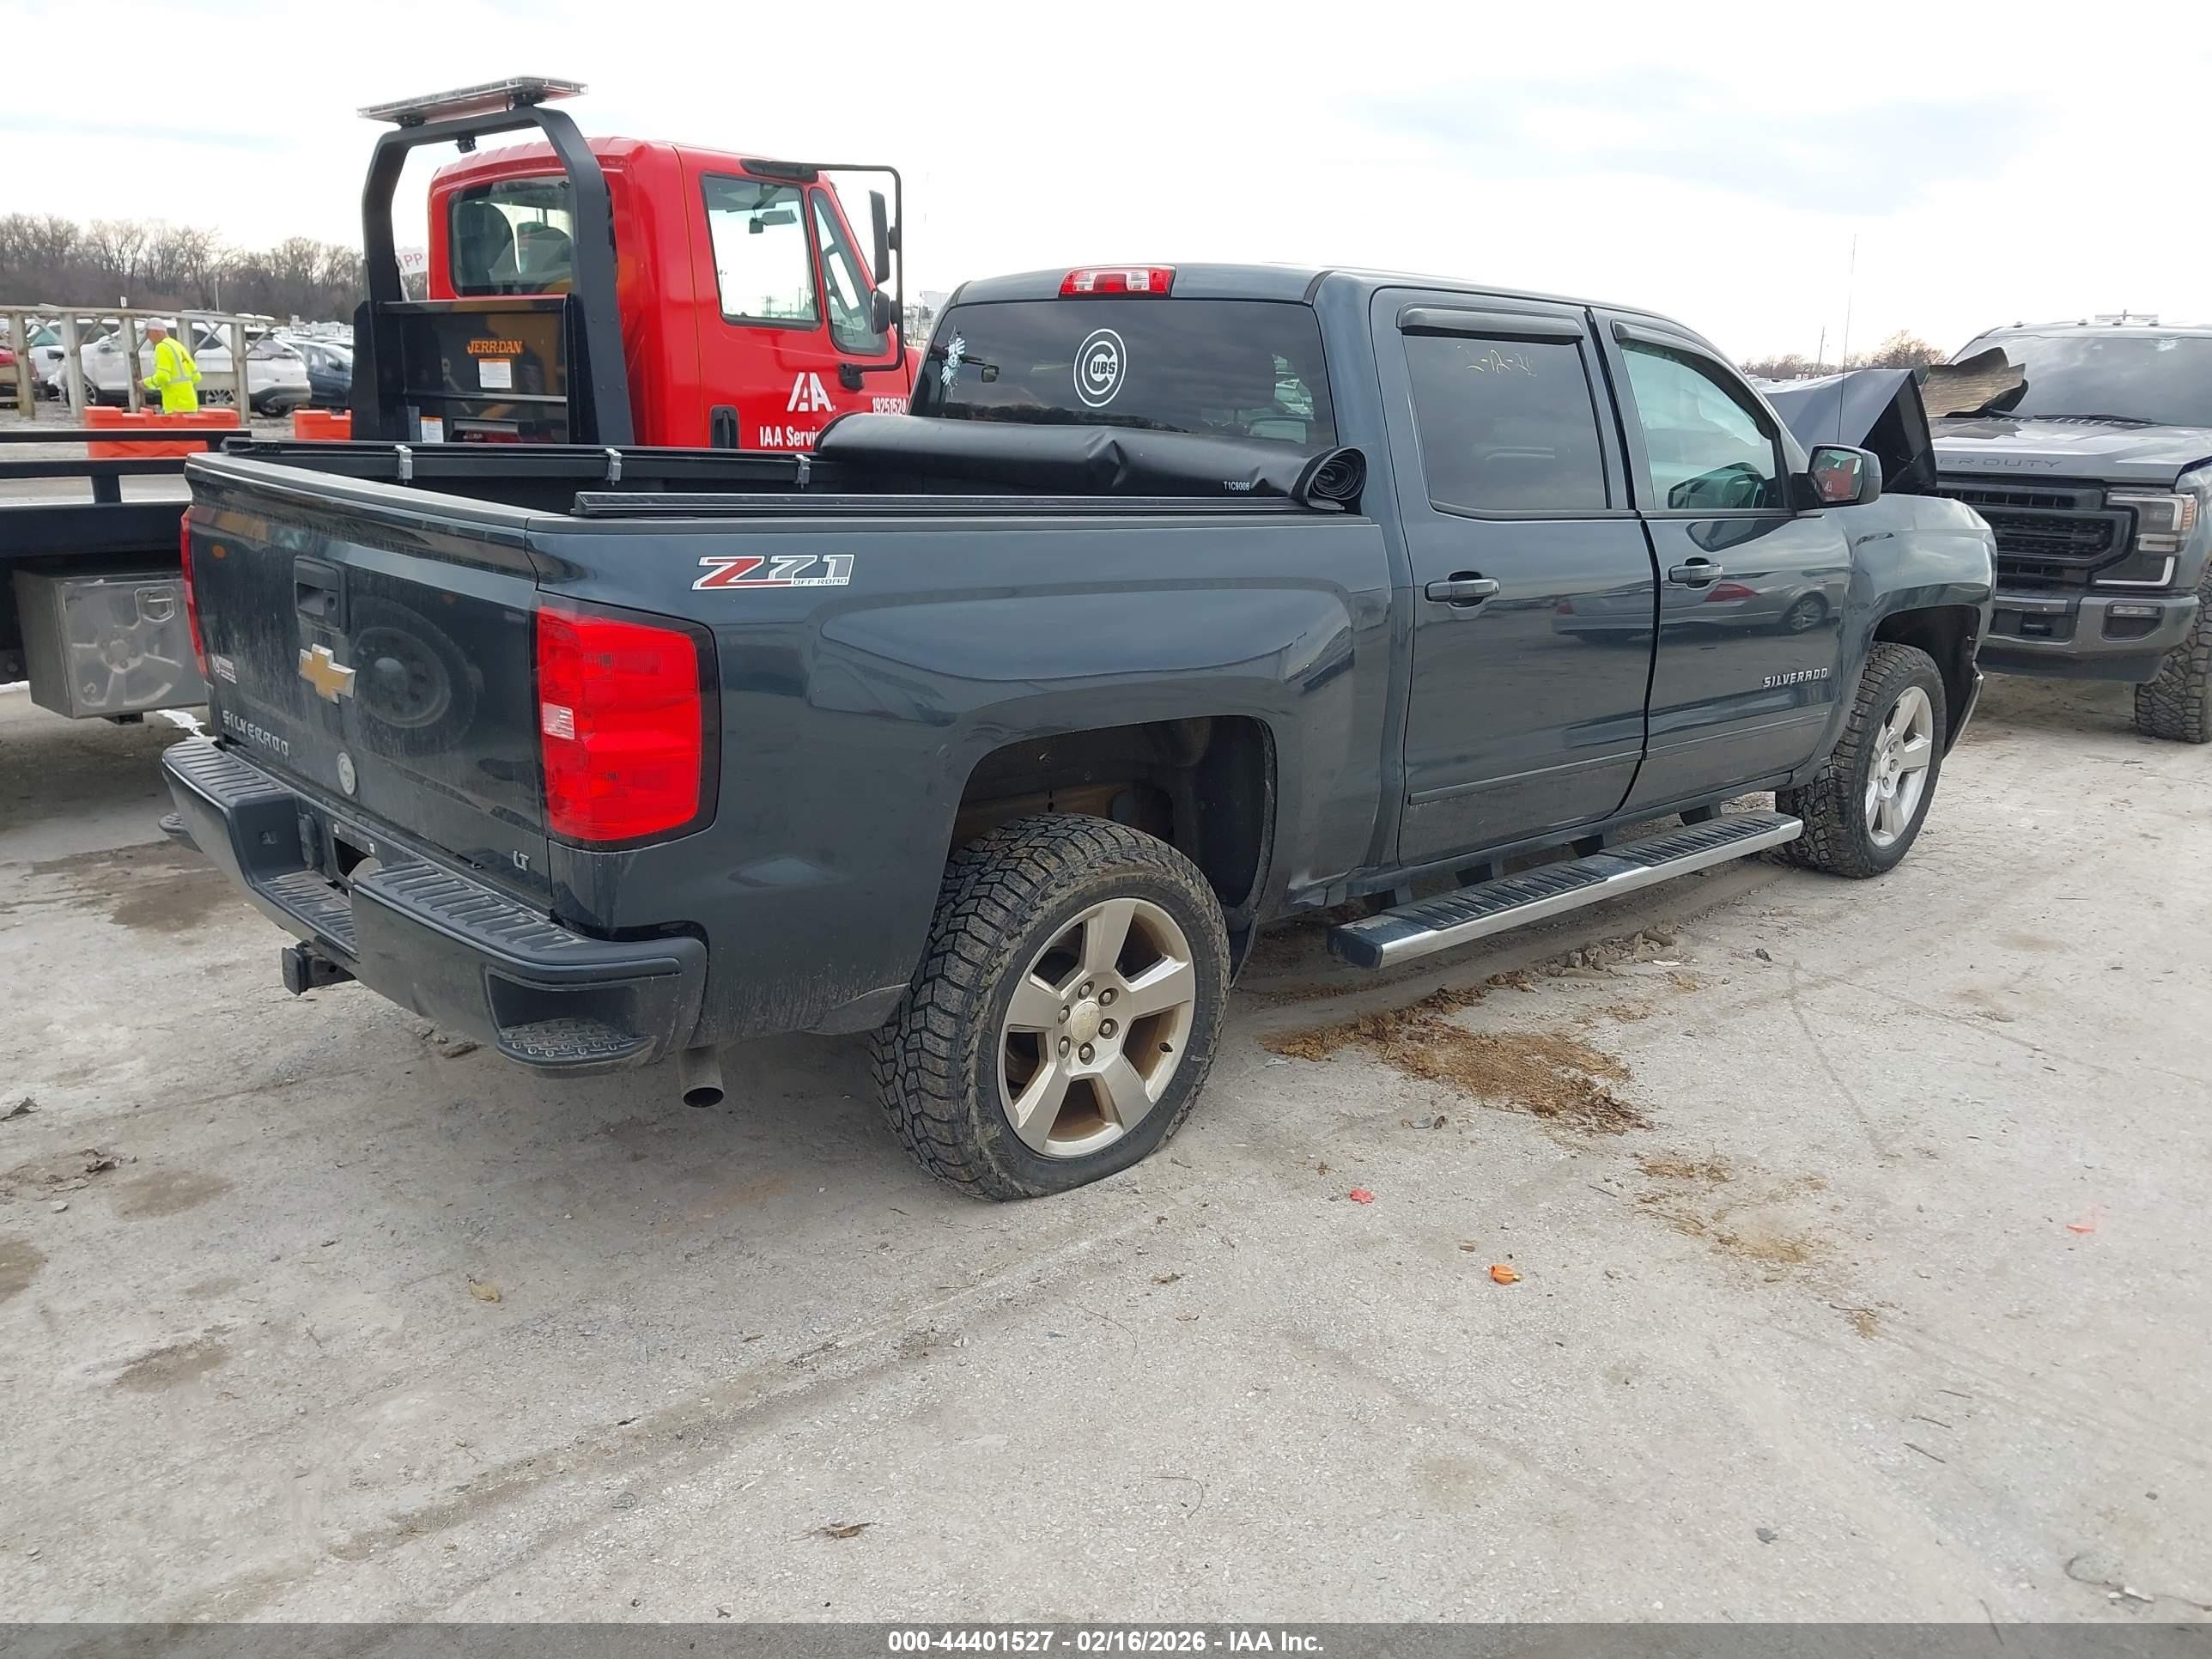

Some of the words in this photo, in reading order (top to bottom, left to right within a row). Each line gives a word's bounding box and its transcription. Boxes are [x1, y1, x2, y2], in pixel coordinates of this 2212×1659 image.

[759, 426, 783, 447] IAA
[1983, 459, 2062, 468] DUTY
[691, 555, 854, 590] Z71
[817, 577, 848, 586] ROAD
[1763, 667, 1828, 688] SILVERADO
[222, 709, 289, 757] SILVERADO
[513, 850, 530, 872] LT
